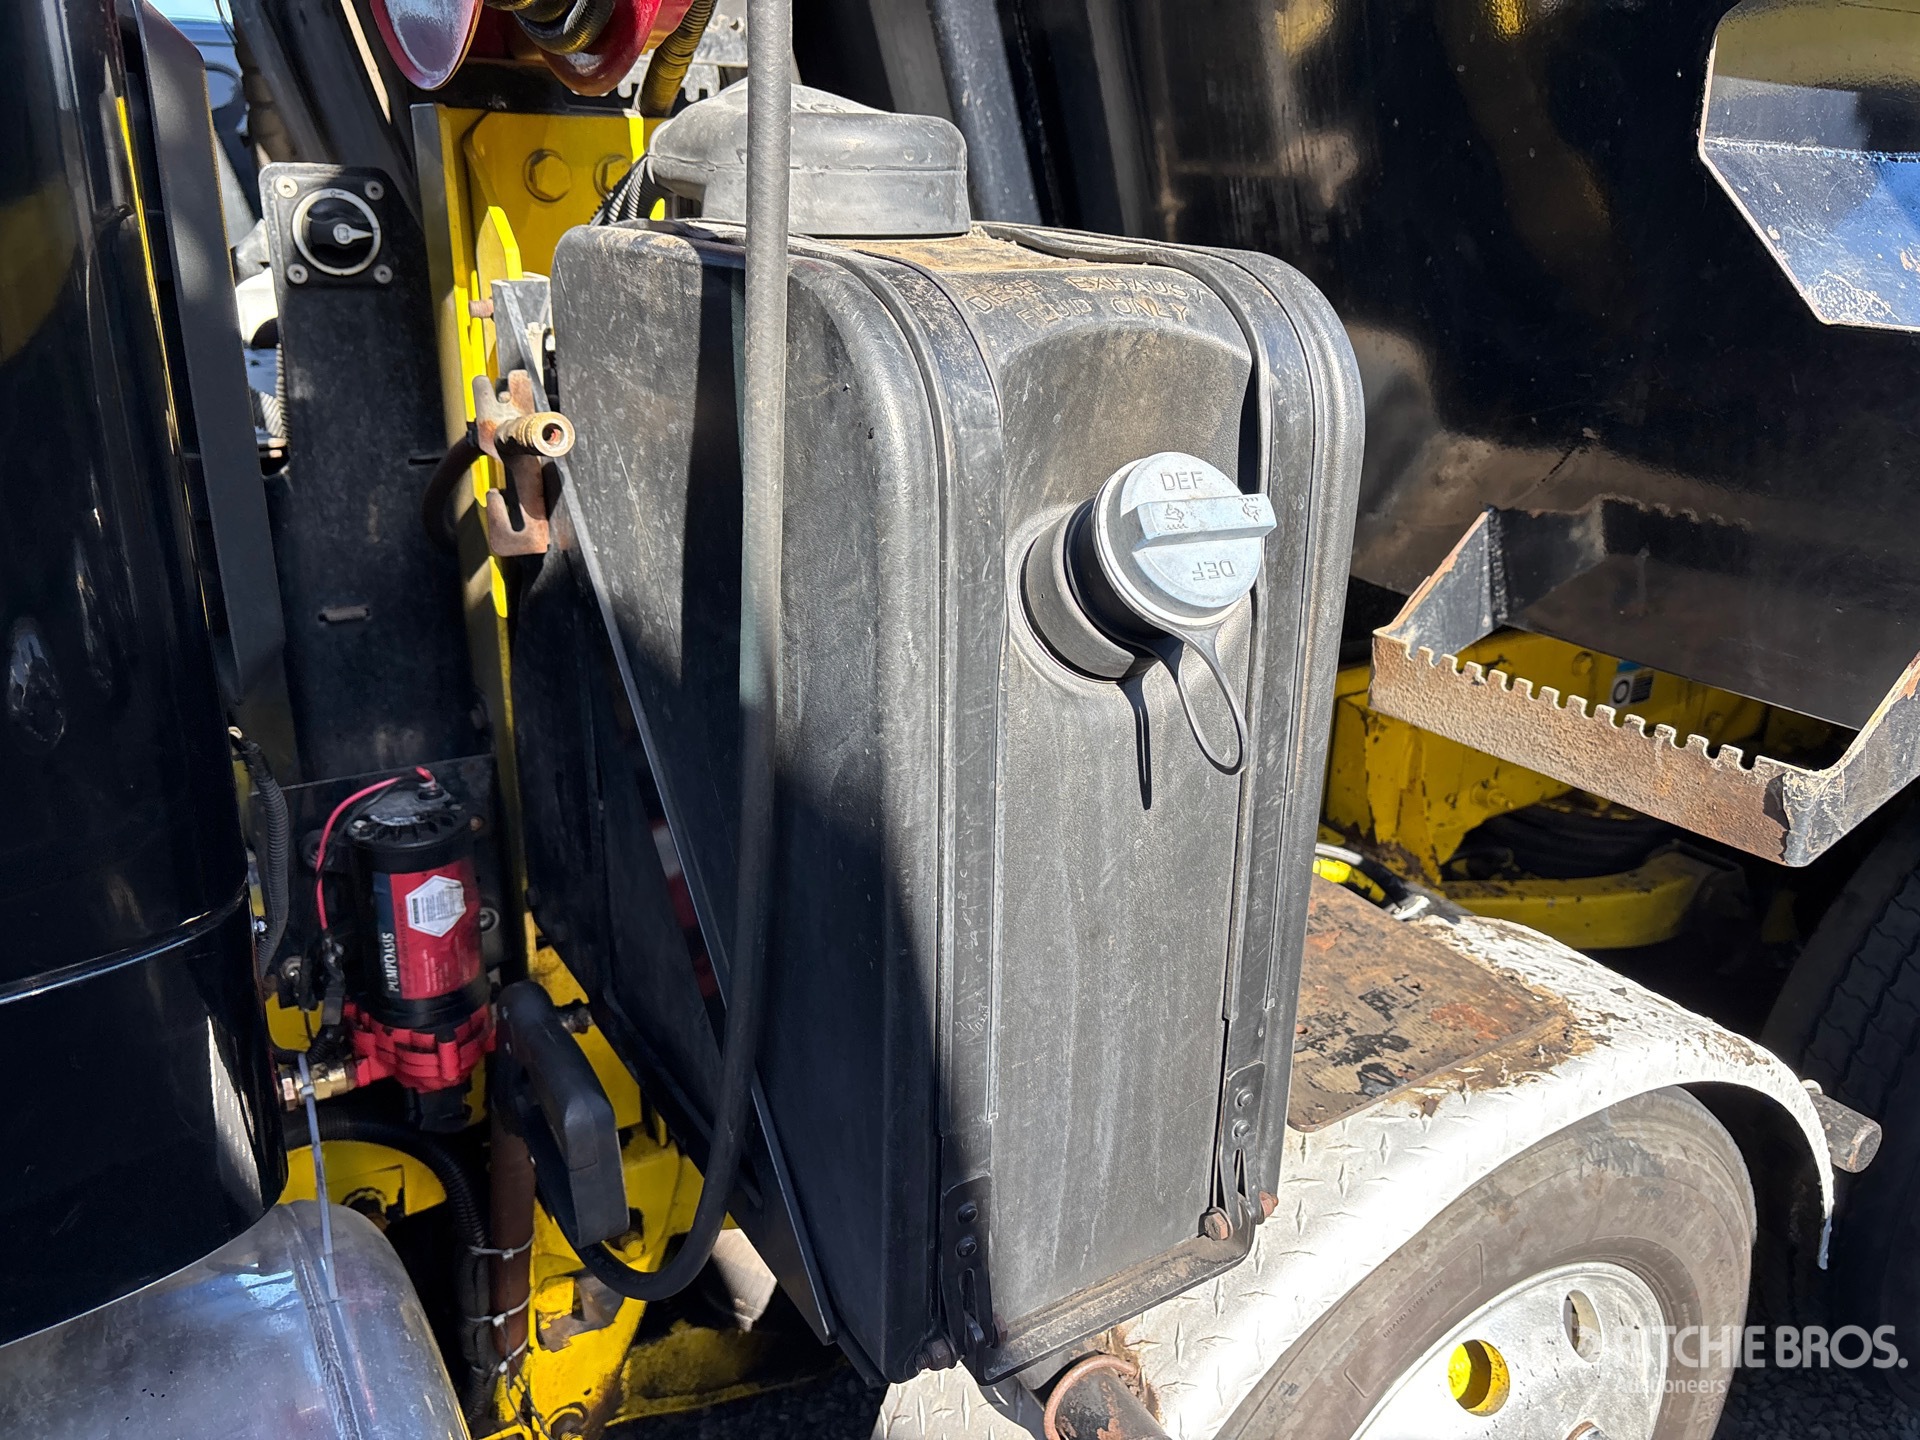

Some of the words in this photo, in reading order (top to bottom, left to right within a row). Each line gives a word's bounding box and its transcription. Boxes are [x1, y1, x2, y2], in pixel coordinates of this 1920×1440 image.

[1065, 276, 1214, 301] EXHAUST
[1015, 297, 1094, 330] FLUID
[1110, 297, 1188, 322] ONLY
[1160, 471, 1204, 491] DEF
[1192, 559, 1236, 581] DEF
[382, 932, 399, 992] PUMPOASIS
